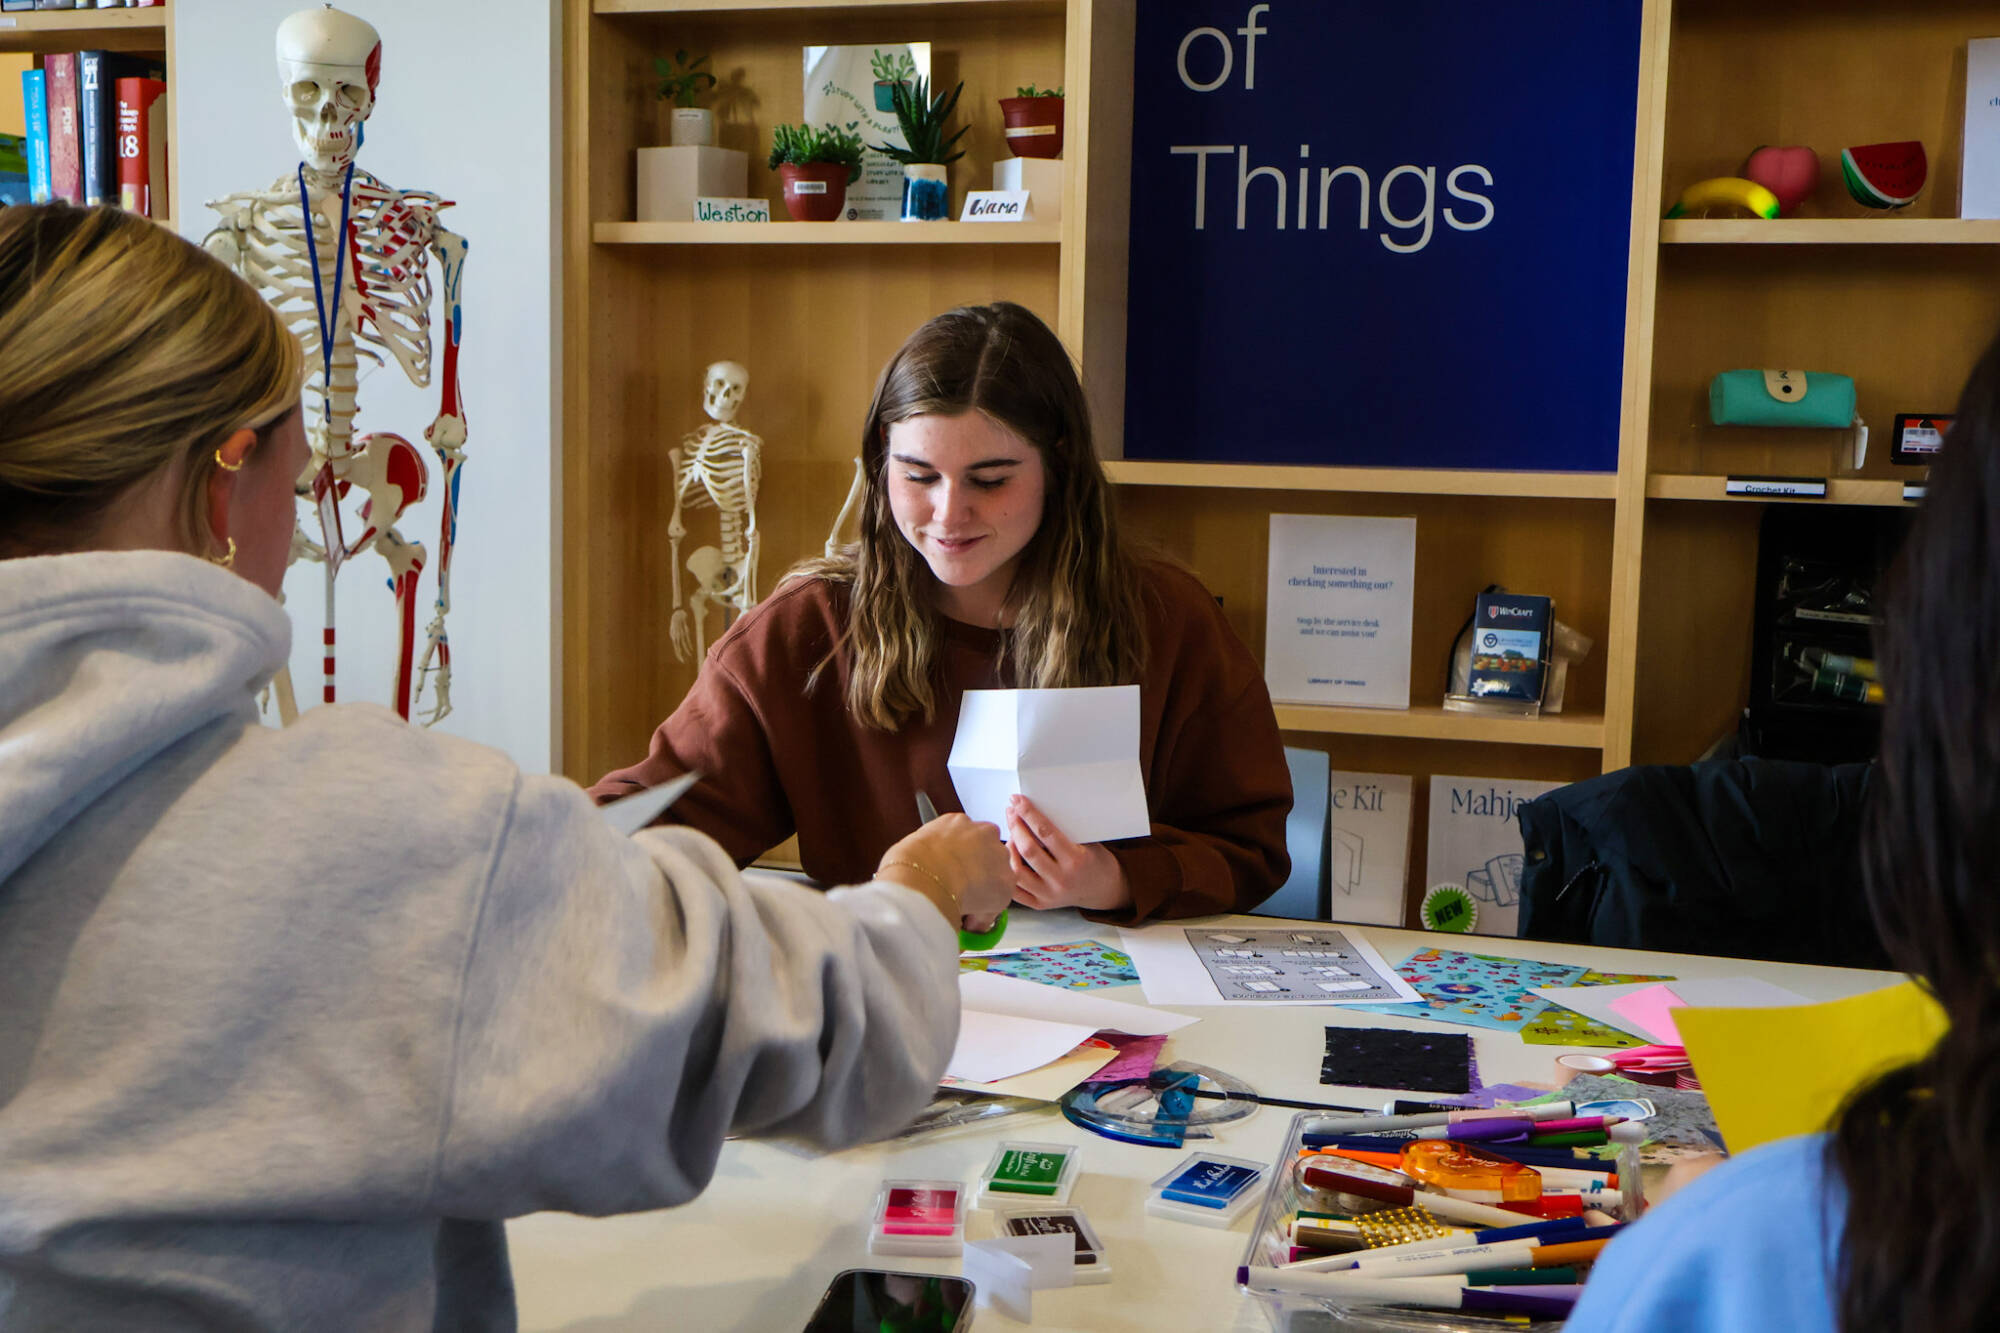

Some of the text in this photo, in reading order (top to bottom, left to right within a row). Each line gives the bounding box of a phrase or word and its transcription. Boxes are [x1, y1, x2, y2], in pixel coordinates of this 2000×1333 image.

[1177, 4, 1270, 92] of
[1170, 144, 1495, 253] Things
[697, 201, 768, 223] Weston
[1745, 485, 1781, 494] Crochet
[1313, 565, 1367, 576] Interested in
[1288, 577, 1394, 591] checking something out?
[1362, 619, 1379, 627] desk
[1331, 785, 1385, 812] e Kit
[1452, 787, 1533, 824] Mahjo
[1435, 898, 1463, 926] NEW
